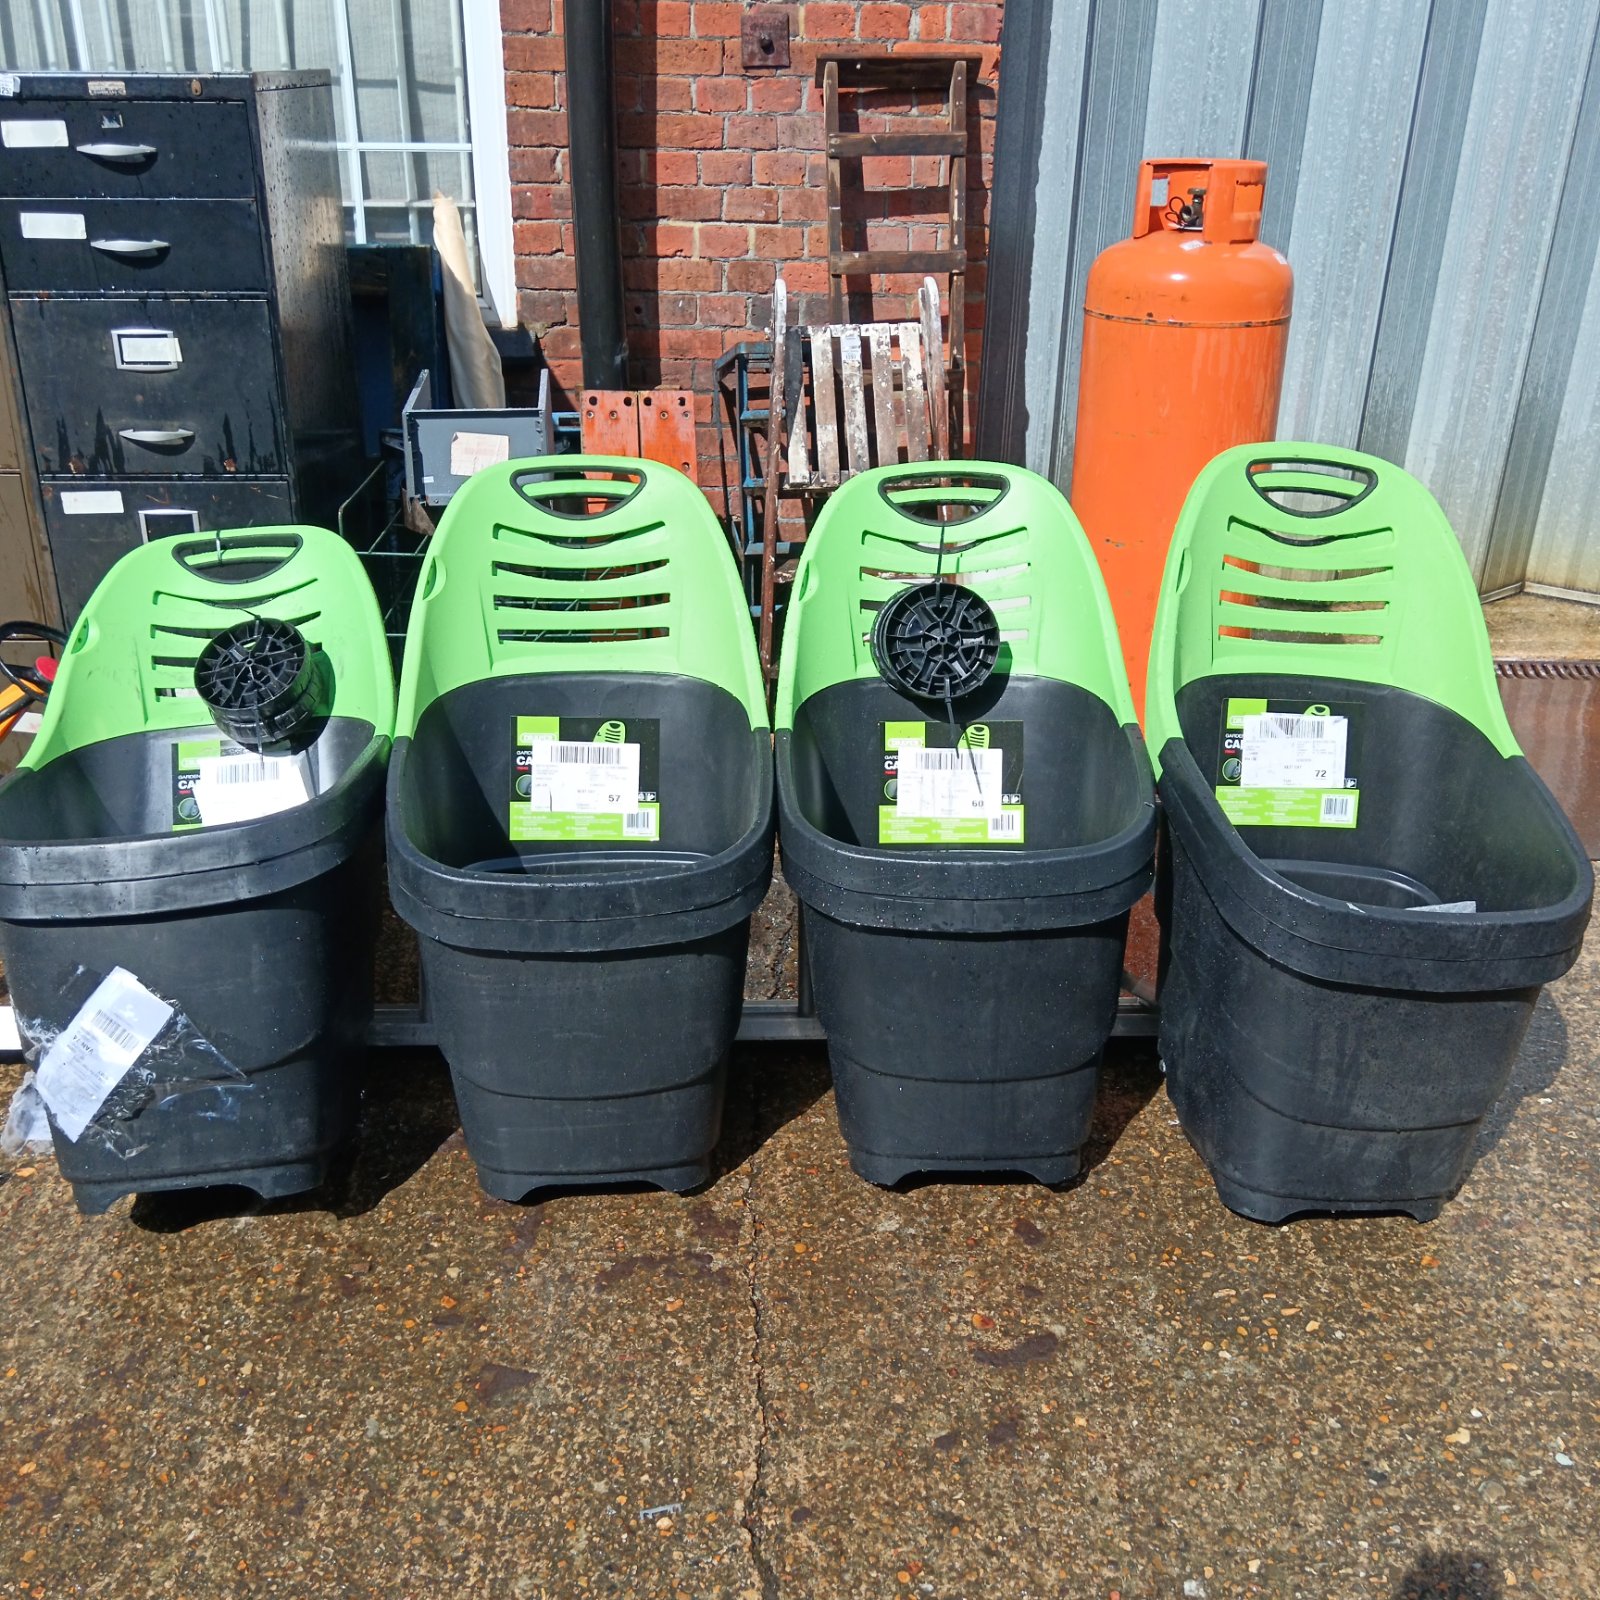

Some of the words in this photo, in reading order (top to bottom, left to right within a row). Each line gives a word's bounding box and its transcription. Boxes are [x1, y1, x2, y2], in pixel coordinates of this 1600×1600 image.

[1224, 739, 1244, 749] CA
[516, 755, 533, 766] CA
[884, 760, 898, 770] CA
[1314, 769, 1327, 778] 72
[177, 780, 198, 790] CA
[608, 794, 621, 803] 57
[972, 800, 985, 808] 60
